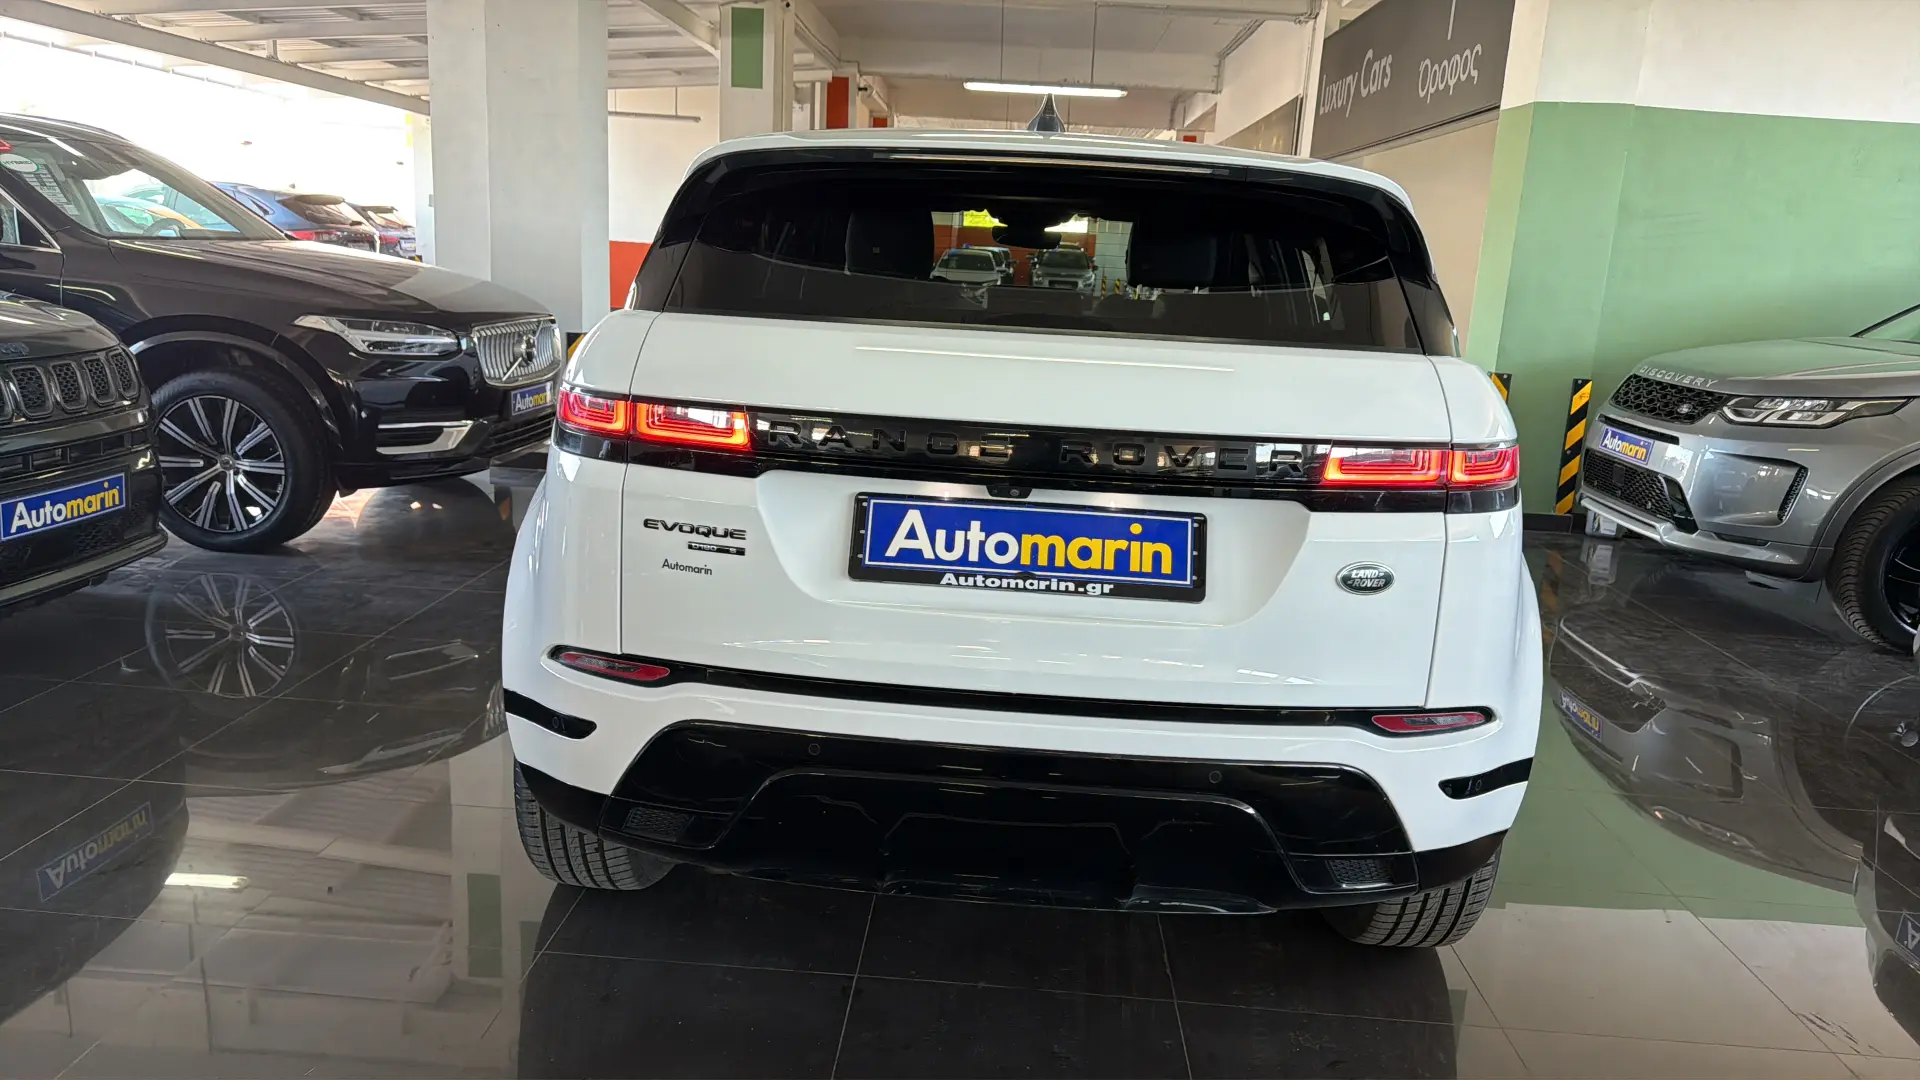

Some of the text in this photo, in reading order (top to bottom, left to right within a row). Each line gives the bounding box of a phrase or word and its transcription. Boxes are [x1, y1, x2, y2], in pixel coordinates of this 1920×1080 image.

[1319, 48, 1393, 119] Luxury Cars
[1418, 43, 1482, 104] Όροφος
[1639, 365, 1718, 388] DISCOVERY
[768, 420, 1304, 476] RANGE ROVER
[1601, 430, 1647, 461] Automarin
[10, 481, 120, 534] Automarin
[643, 518, 747, 540] EVOQUE
[884, 508, 1173, 575] Automarin
[661, 558, 713, 576] Automarin
[1351, 569, 1379, 578] LAND
[940, 572, 1114, 596] Automarin.gr
[1352, 578, 1385, 587] ROVER
